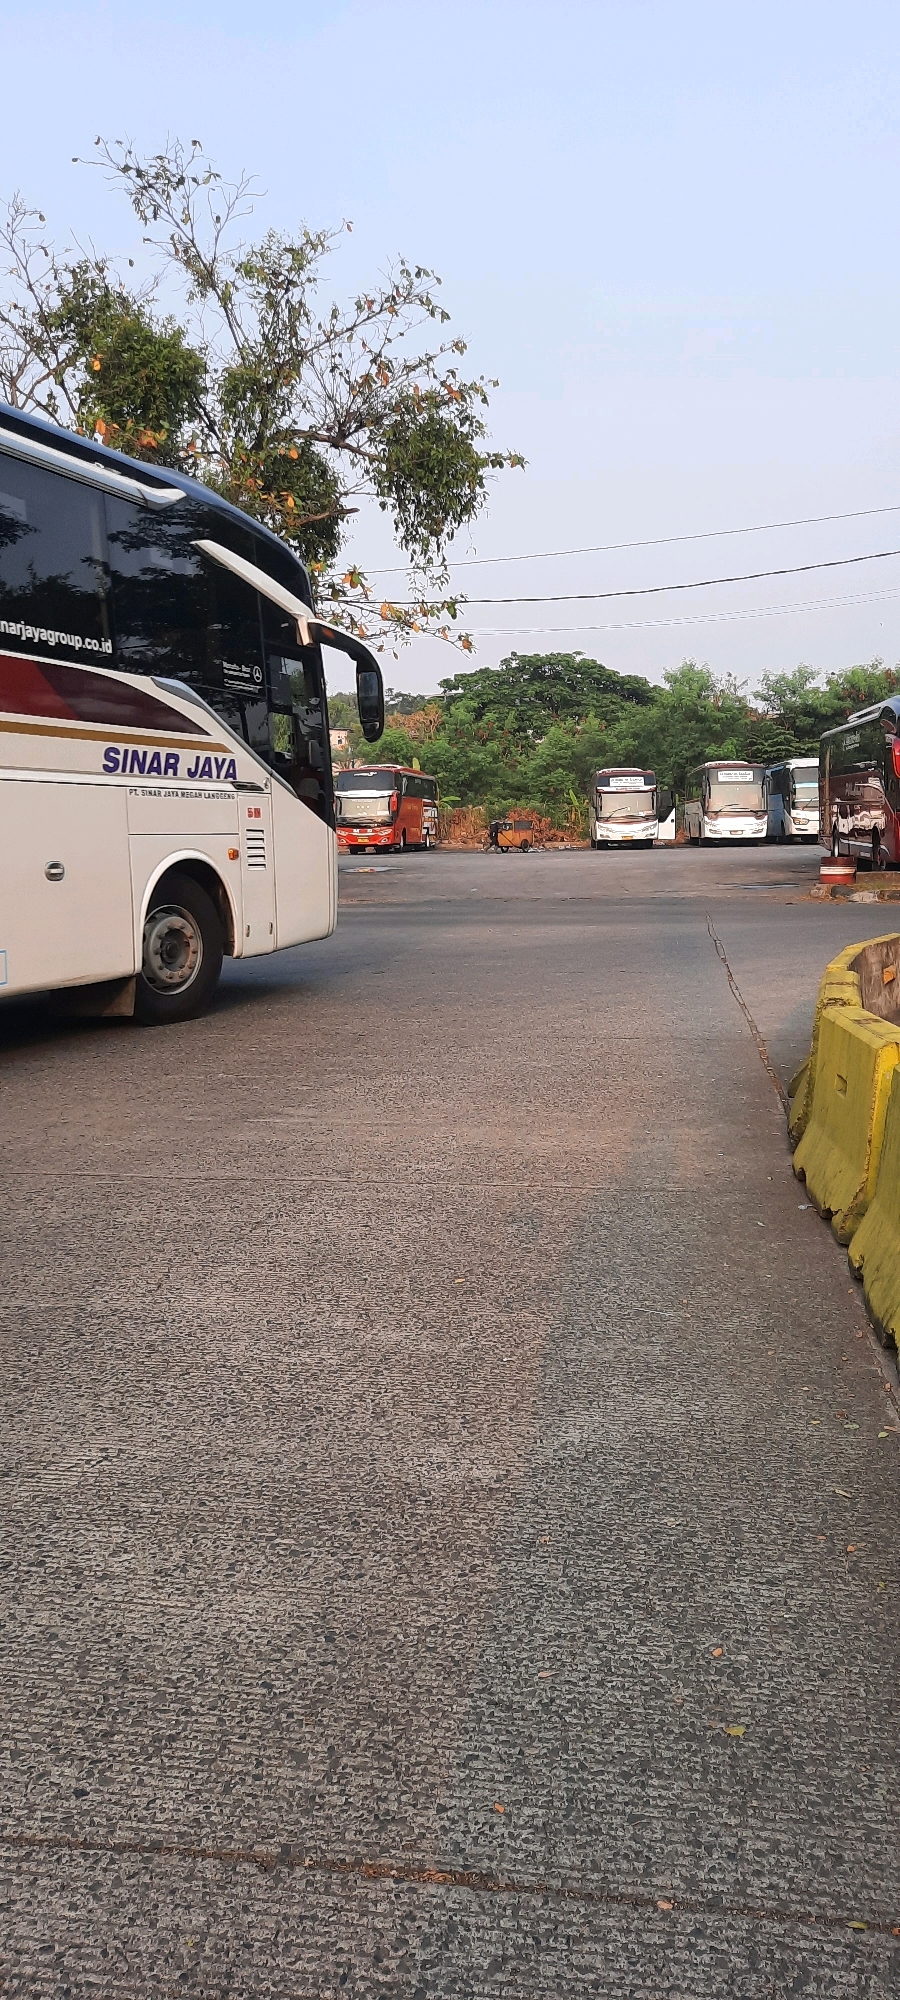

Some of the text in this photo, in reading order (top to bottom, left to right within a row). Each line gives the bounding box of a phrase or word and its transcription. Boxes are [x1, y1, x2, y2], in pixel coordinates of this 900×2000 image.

[0, 620, 113, 654] narjayagroup.co.id
[102, 746, 238, 780] SINAR JAYA
[128, 788, 139, 797] PT.
[141, 789, 162, 798] SINAR
[163, 790, 179, 799] JAYA
